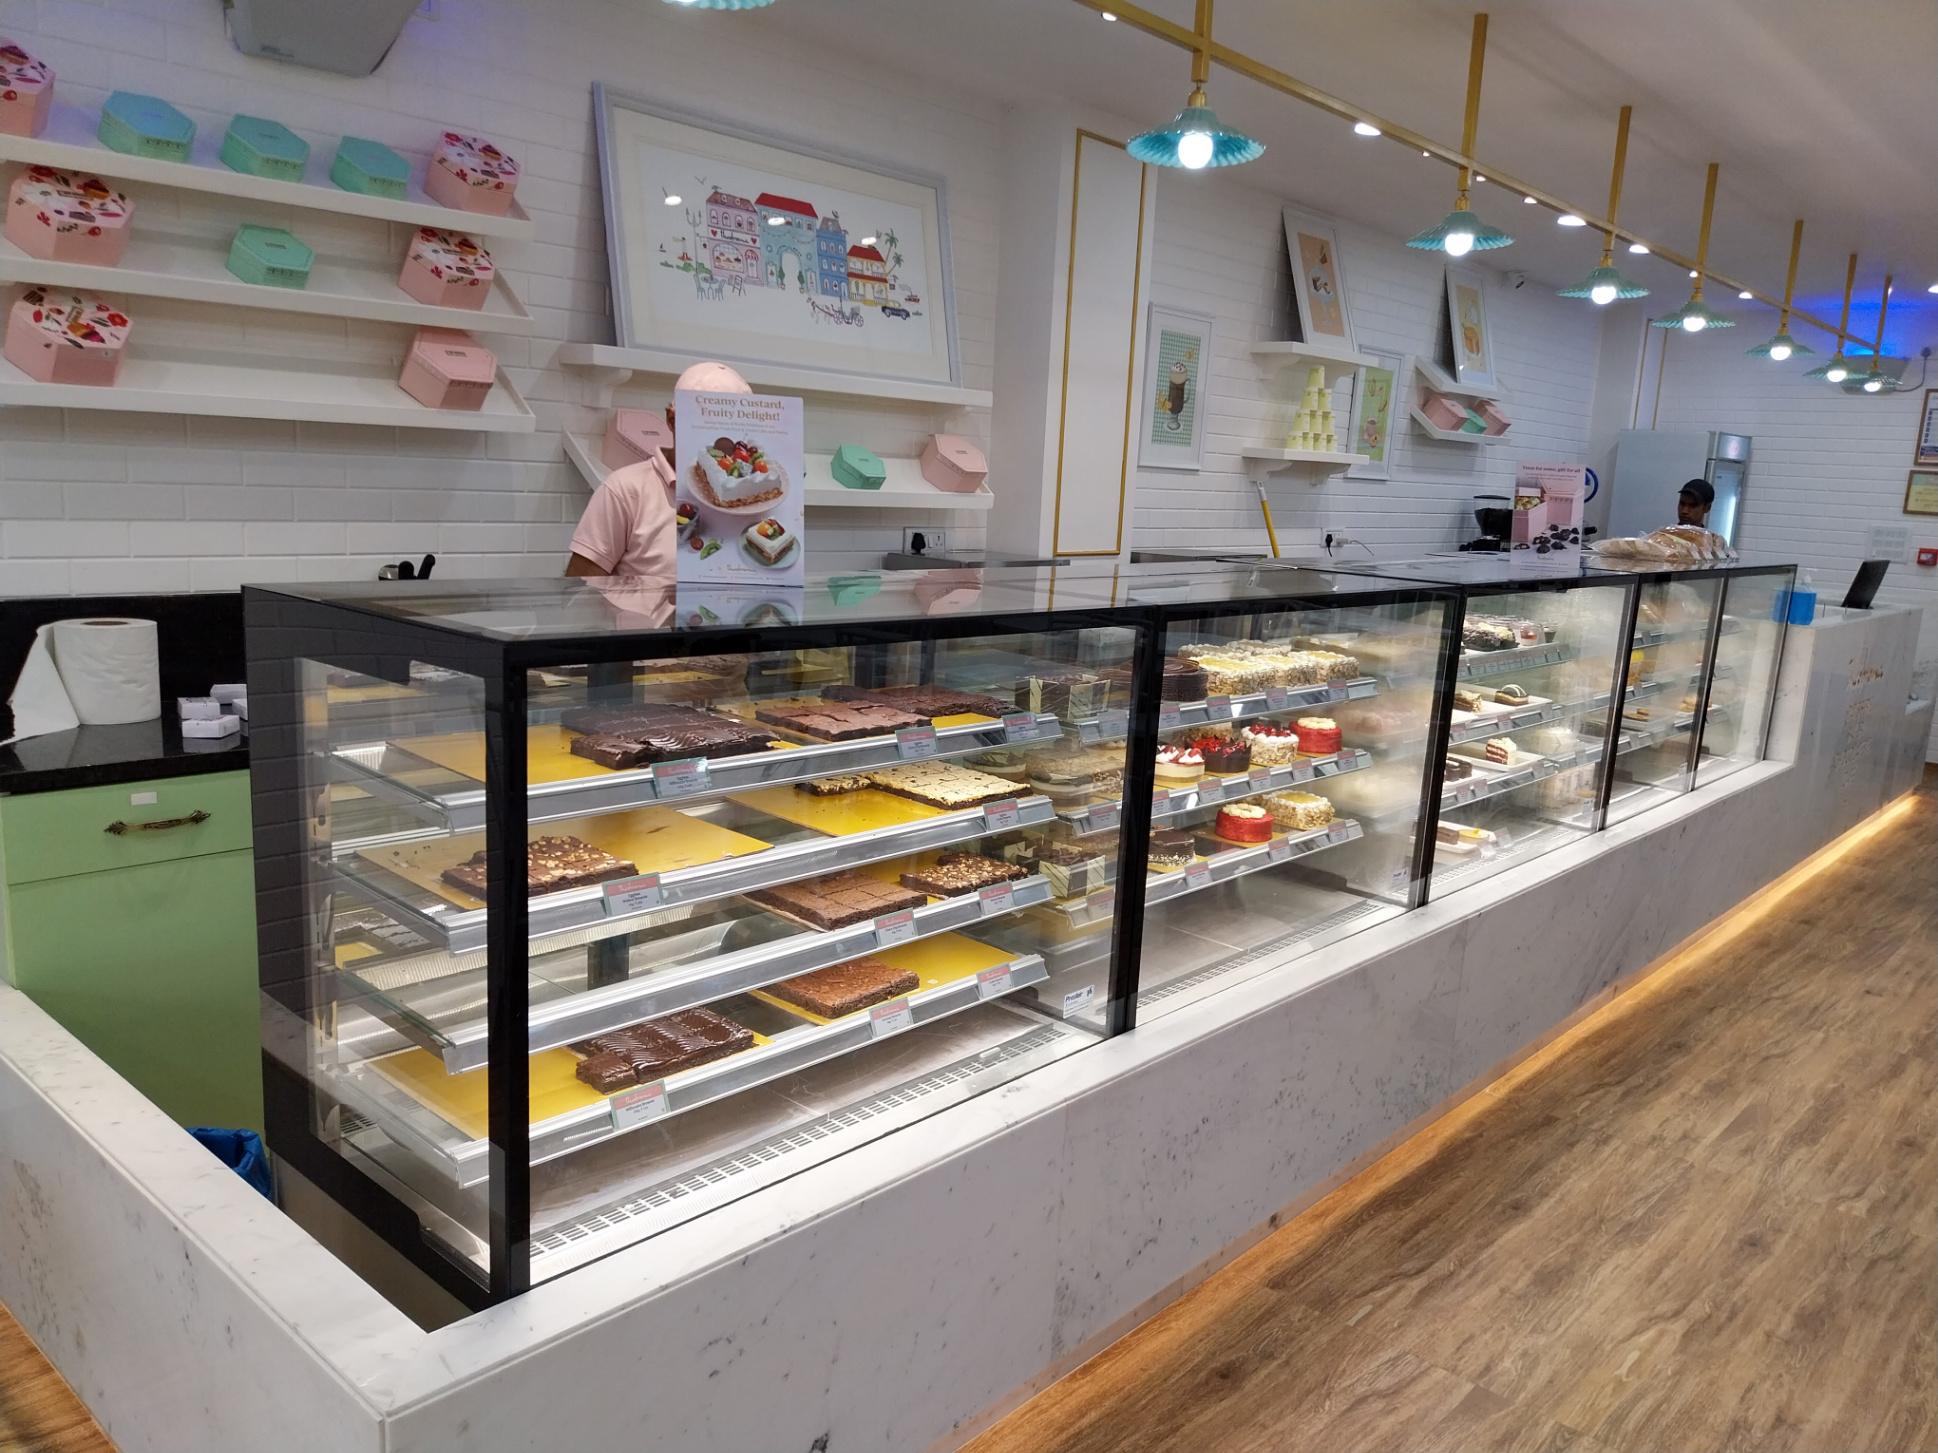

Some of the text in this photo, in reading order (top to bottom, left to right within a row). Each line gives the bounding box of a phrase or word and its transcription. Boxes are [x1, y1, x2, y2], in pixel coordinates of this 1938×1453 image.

[695, 395, 785, 410] Creamy Custard,
[701, 407, 781, 422] Fruity Delight!
